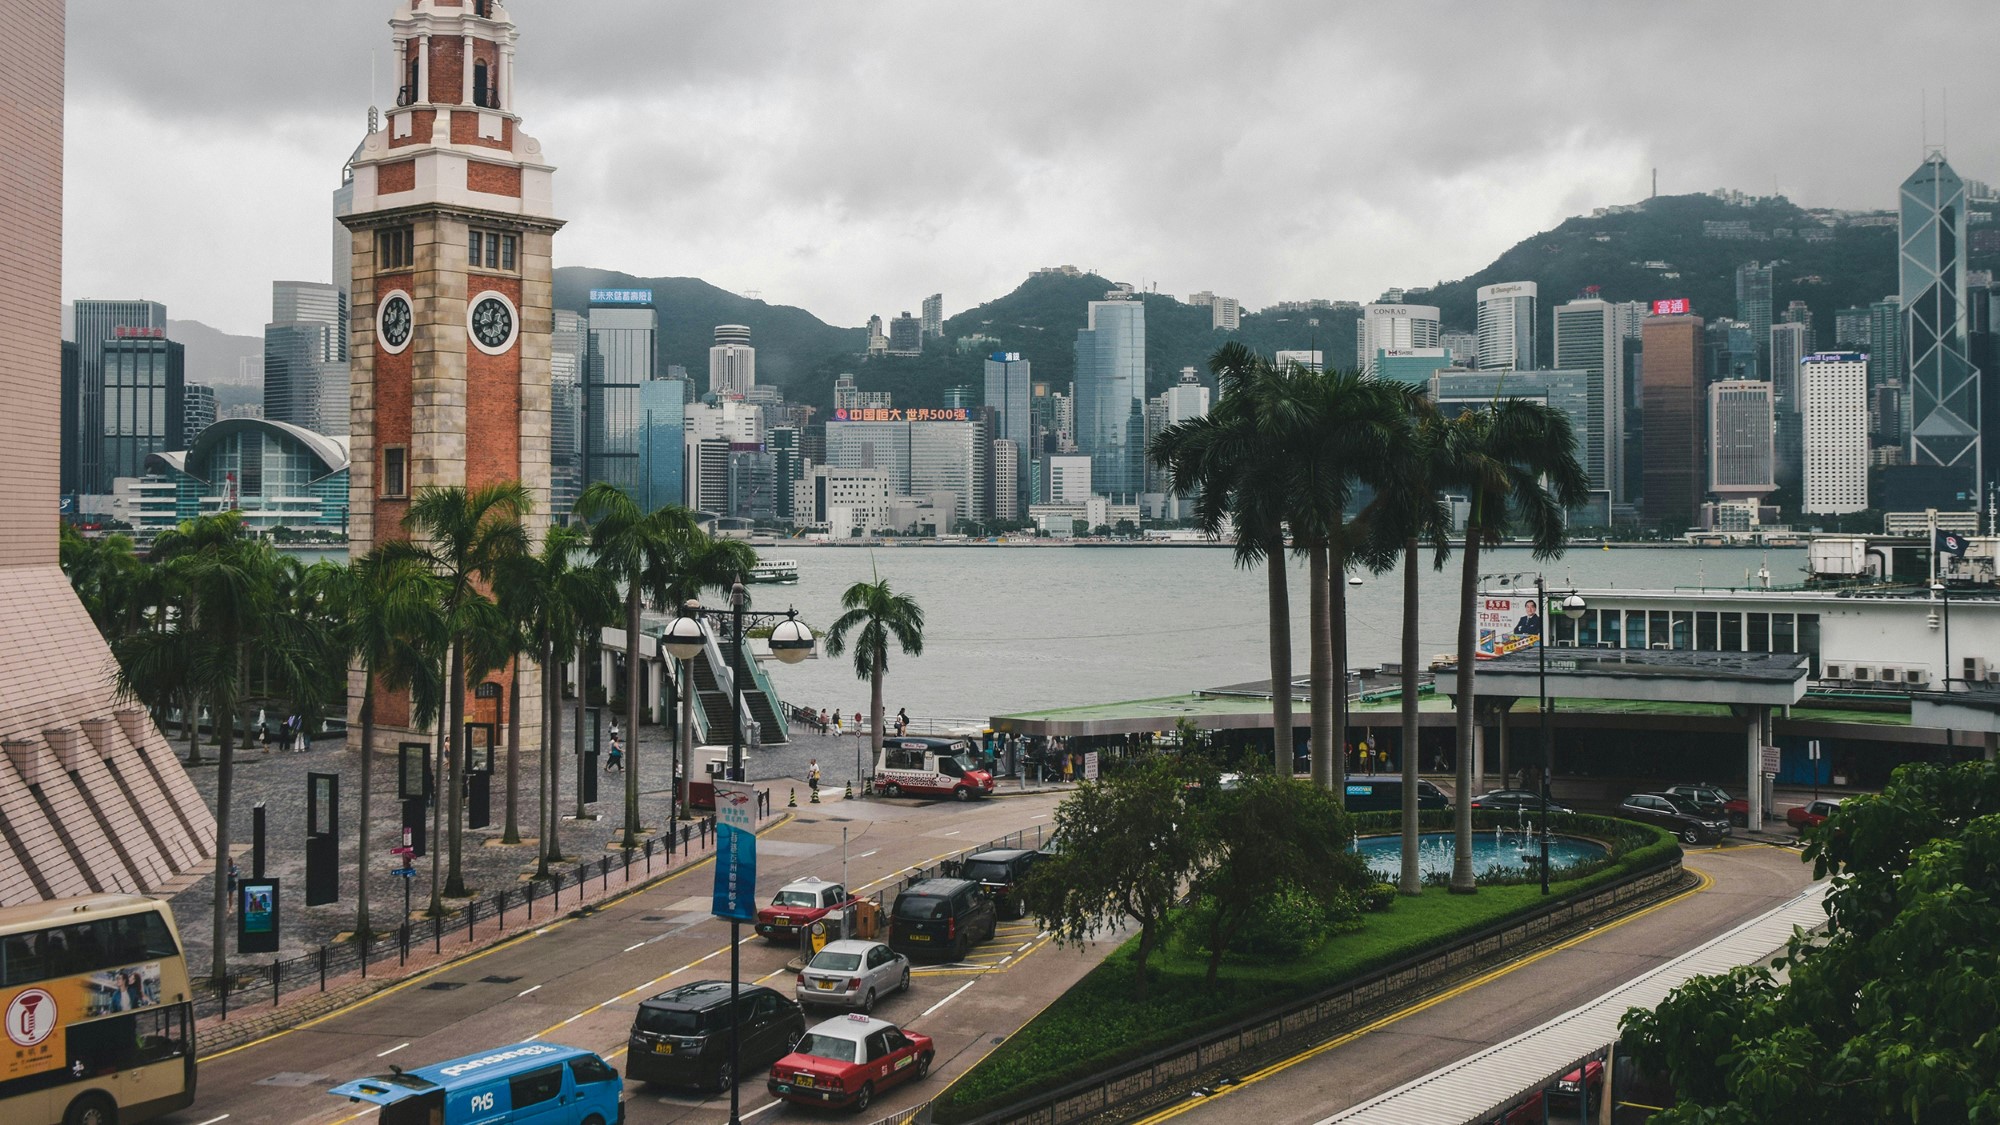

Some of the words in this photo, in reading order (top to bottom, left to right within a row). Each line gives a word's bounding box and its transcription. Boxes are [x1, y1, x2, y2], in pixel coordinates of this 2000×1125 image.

[850, 408, 902, 421] 中国恒大
[905, 408, 966, 421] 世界500强
[471, 1092, 494, 1114] PHS
